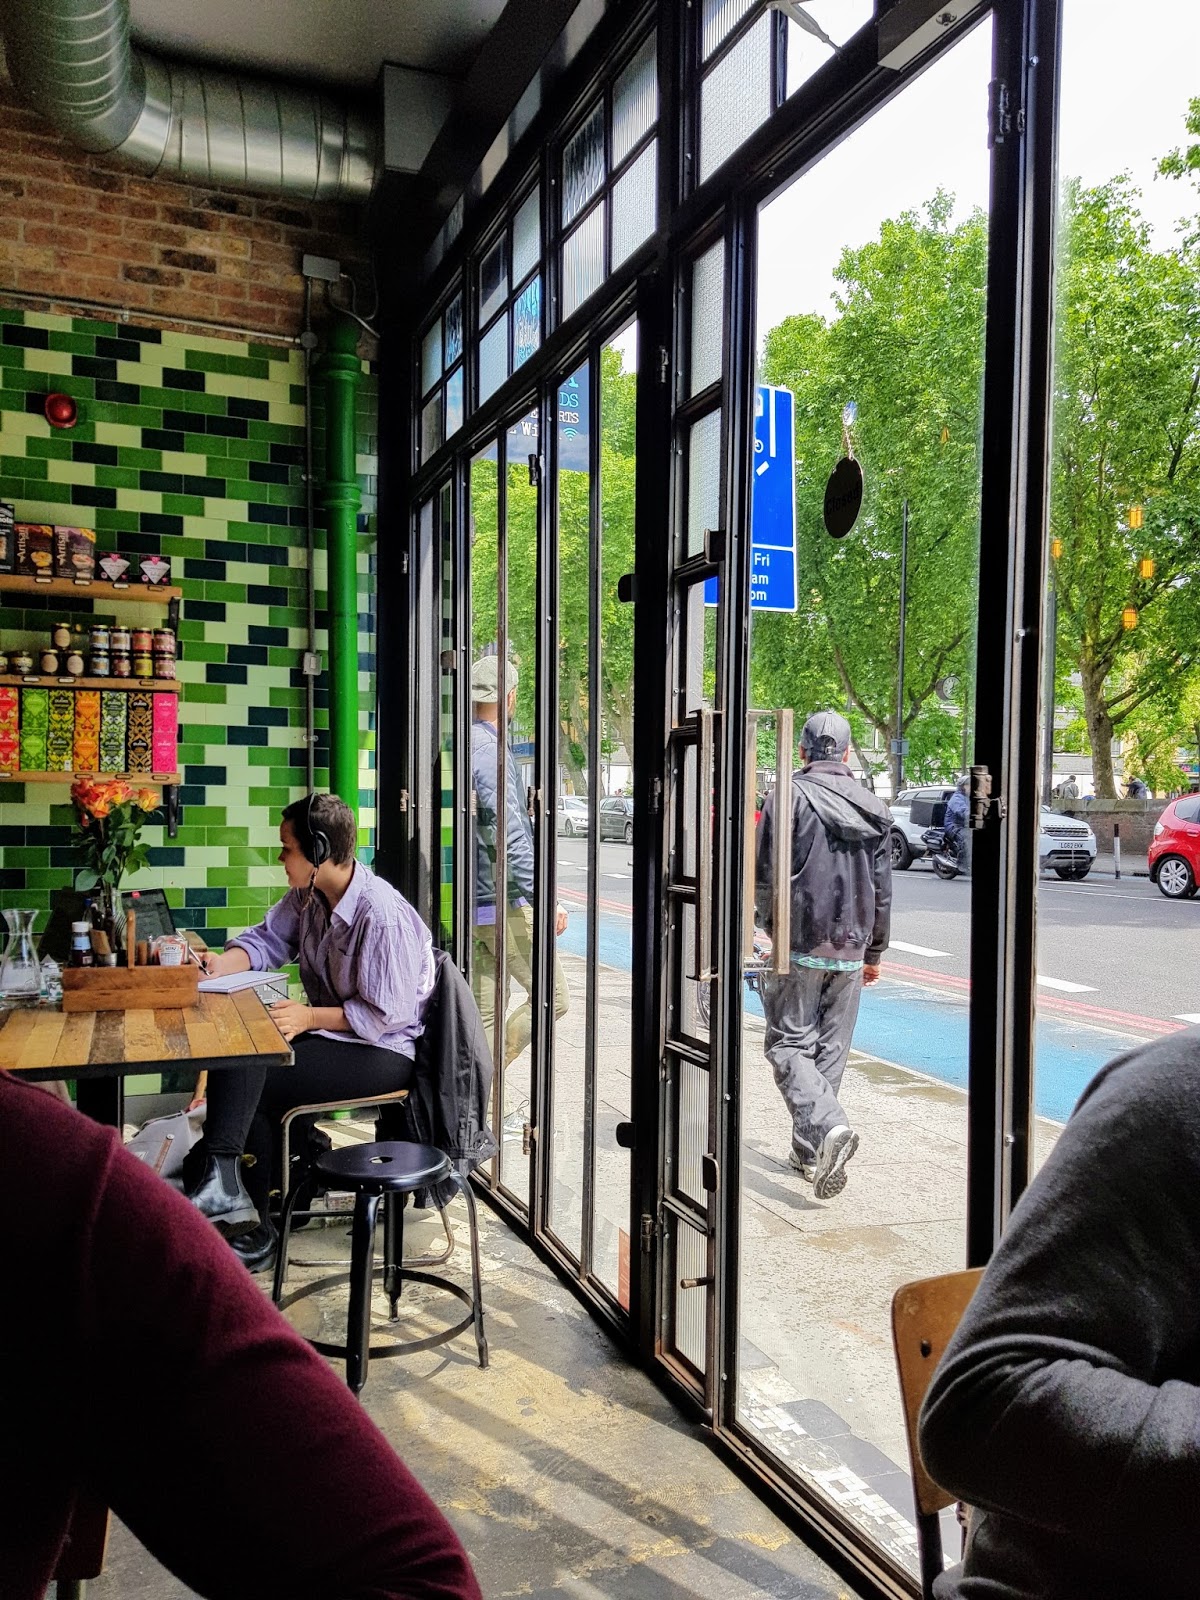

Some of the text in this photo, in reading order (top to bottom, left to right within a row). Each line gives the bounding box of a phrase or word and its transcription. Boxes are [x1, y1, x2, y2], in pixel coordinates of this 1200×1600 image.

[17, 526, 26, 557] Artisan
[57, 529, 66, 560] Artisan
[754, 552, 770, 567] Fri
